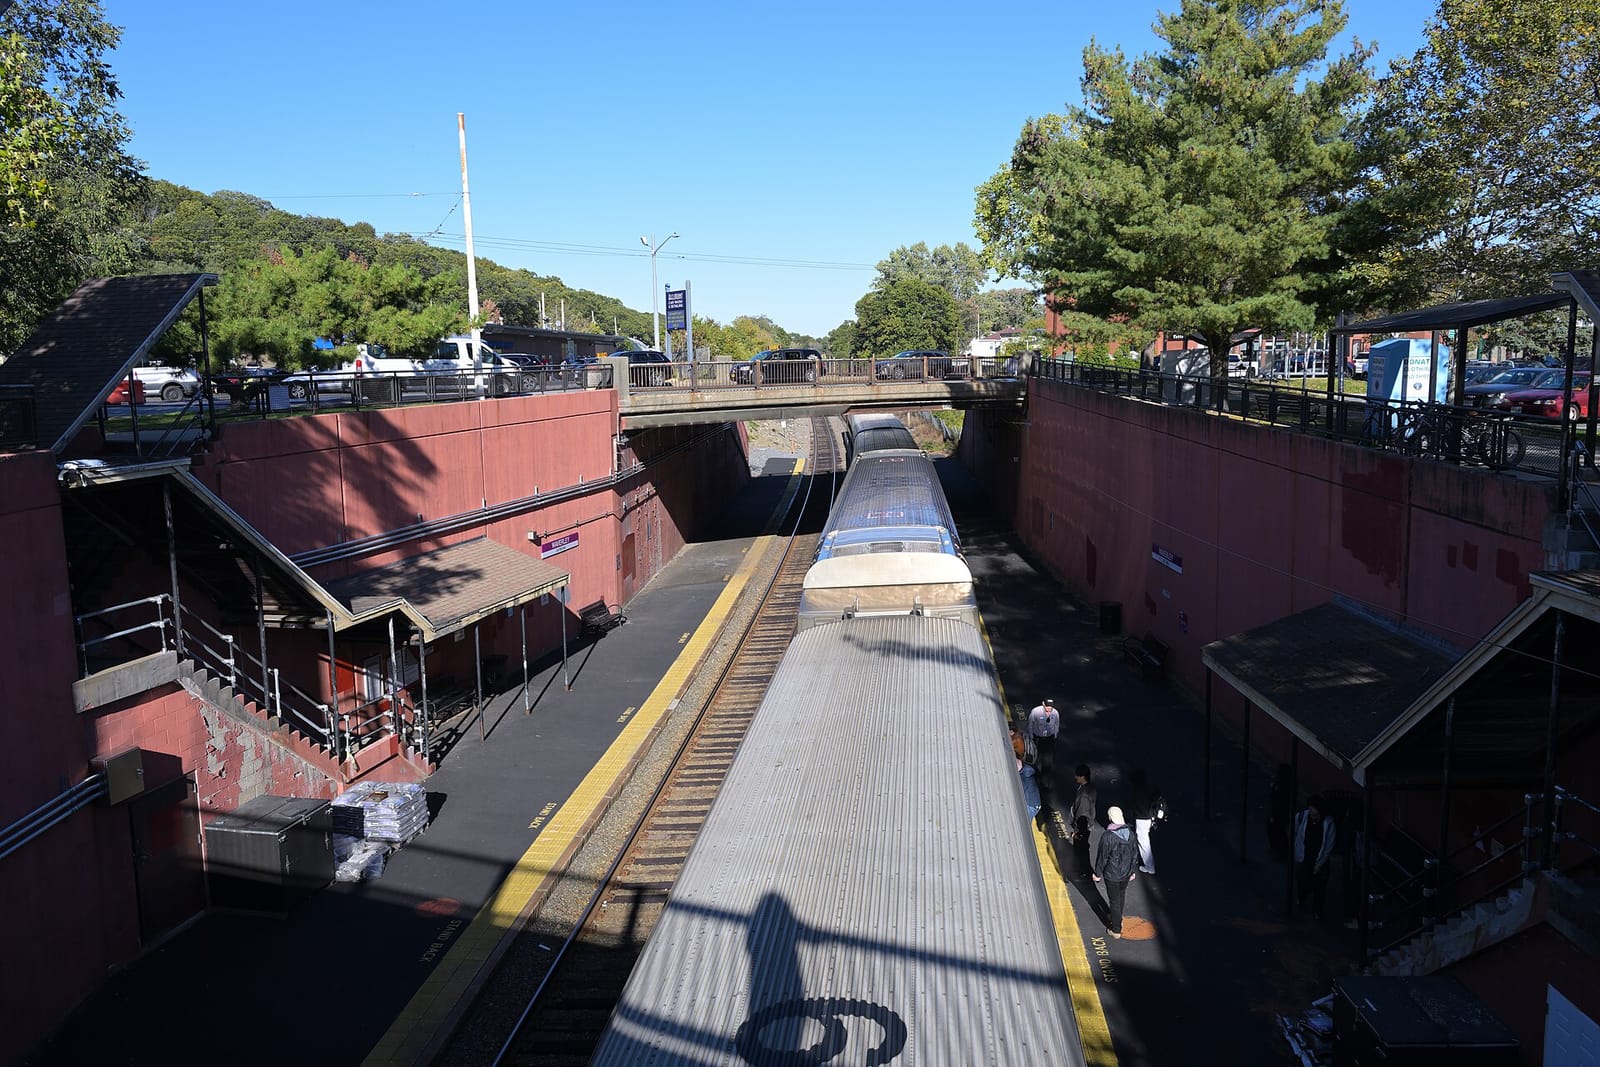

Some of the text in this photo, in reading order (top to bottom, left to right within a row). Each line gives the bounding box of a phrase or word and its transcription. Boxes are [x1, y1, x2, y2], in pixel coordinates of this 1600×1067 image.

[418, 919, 463, 963] STAND BACK
[1091, 936, 1118, 983] STAND BACK
